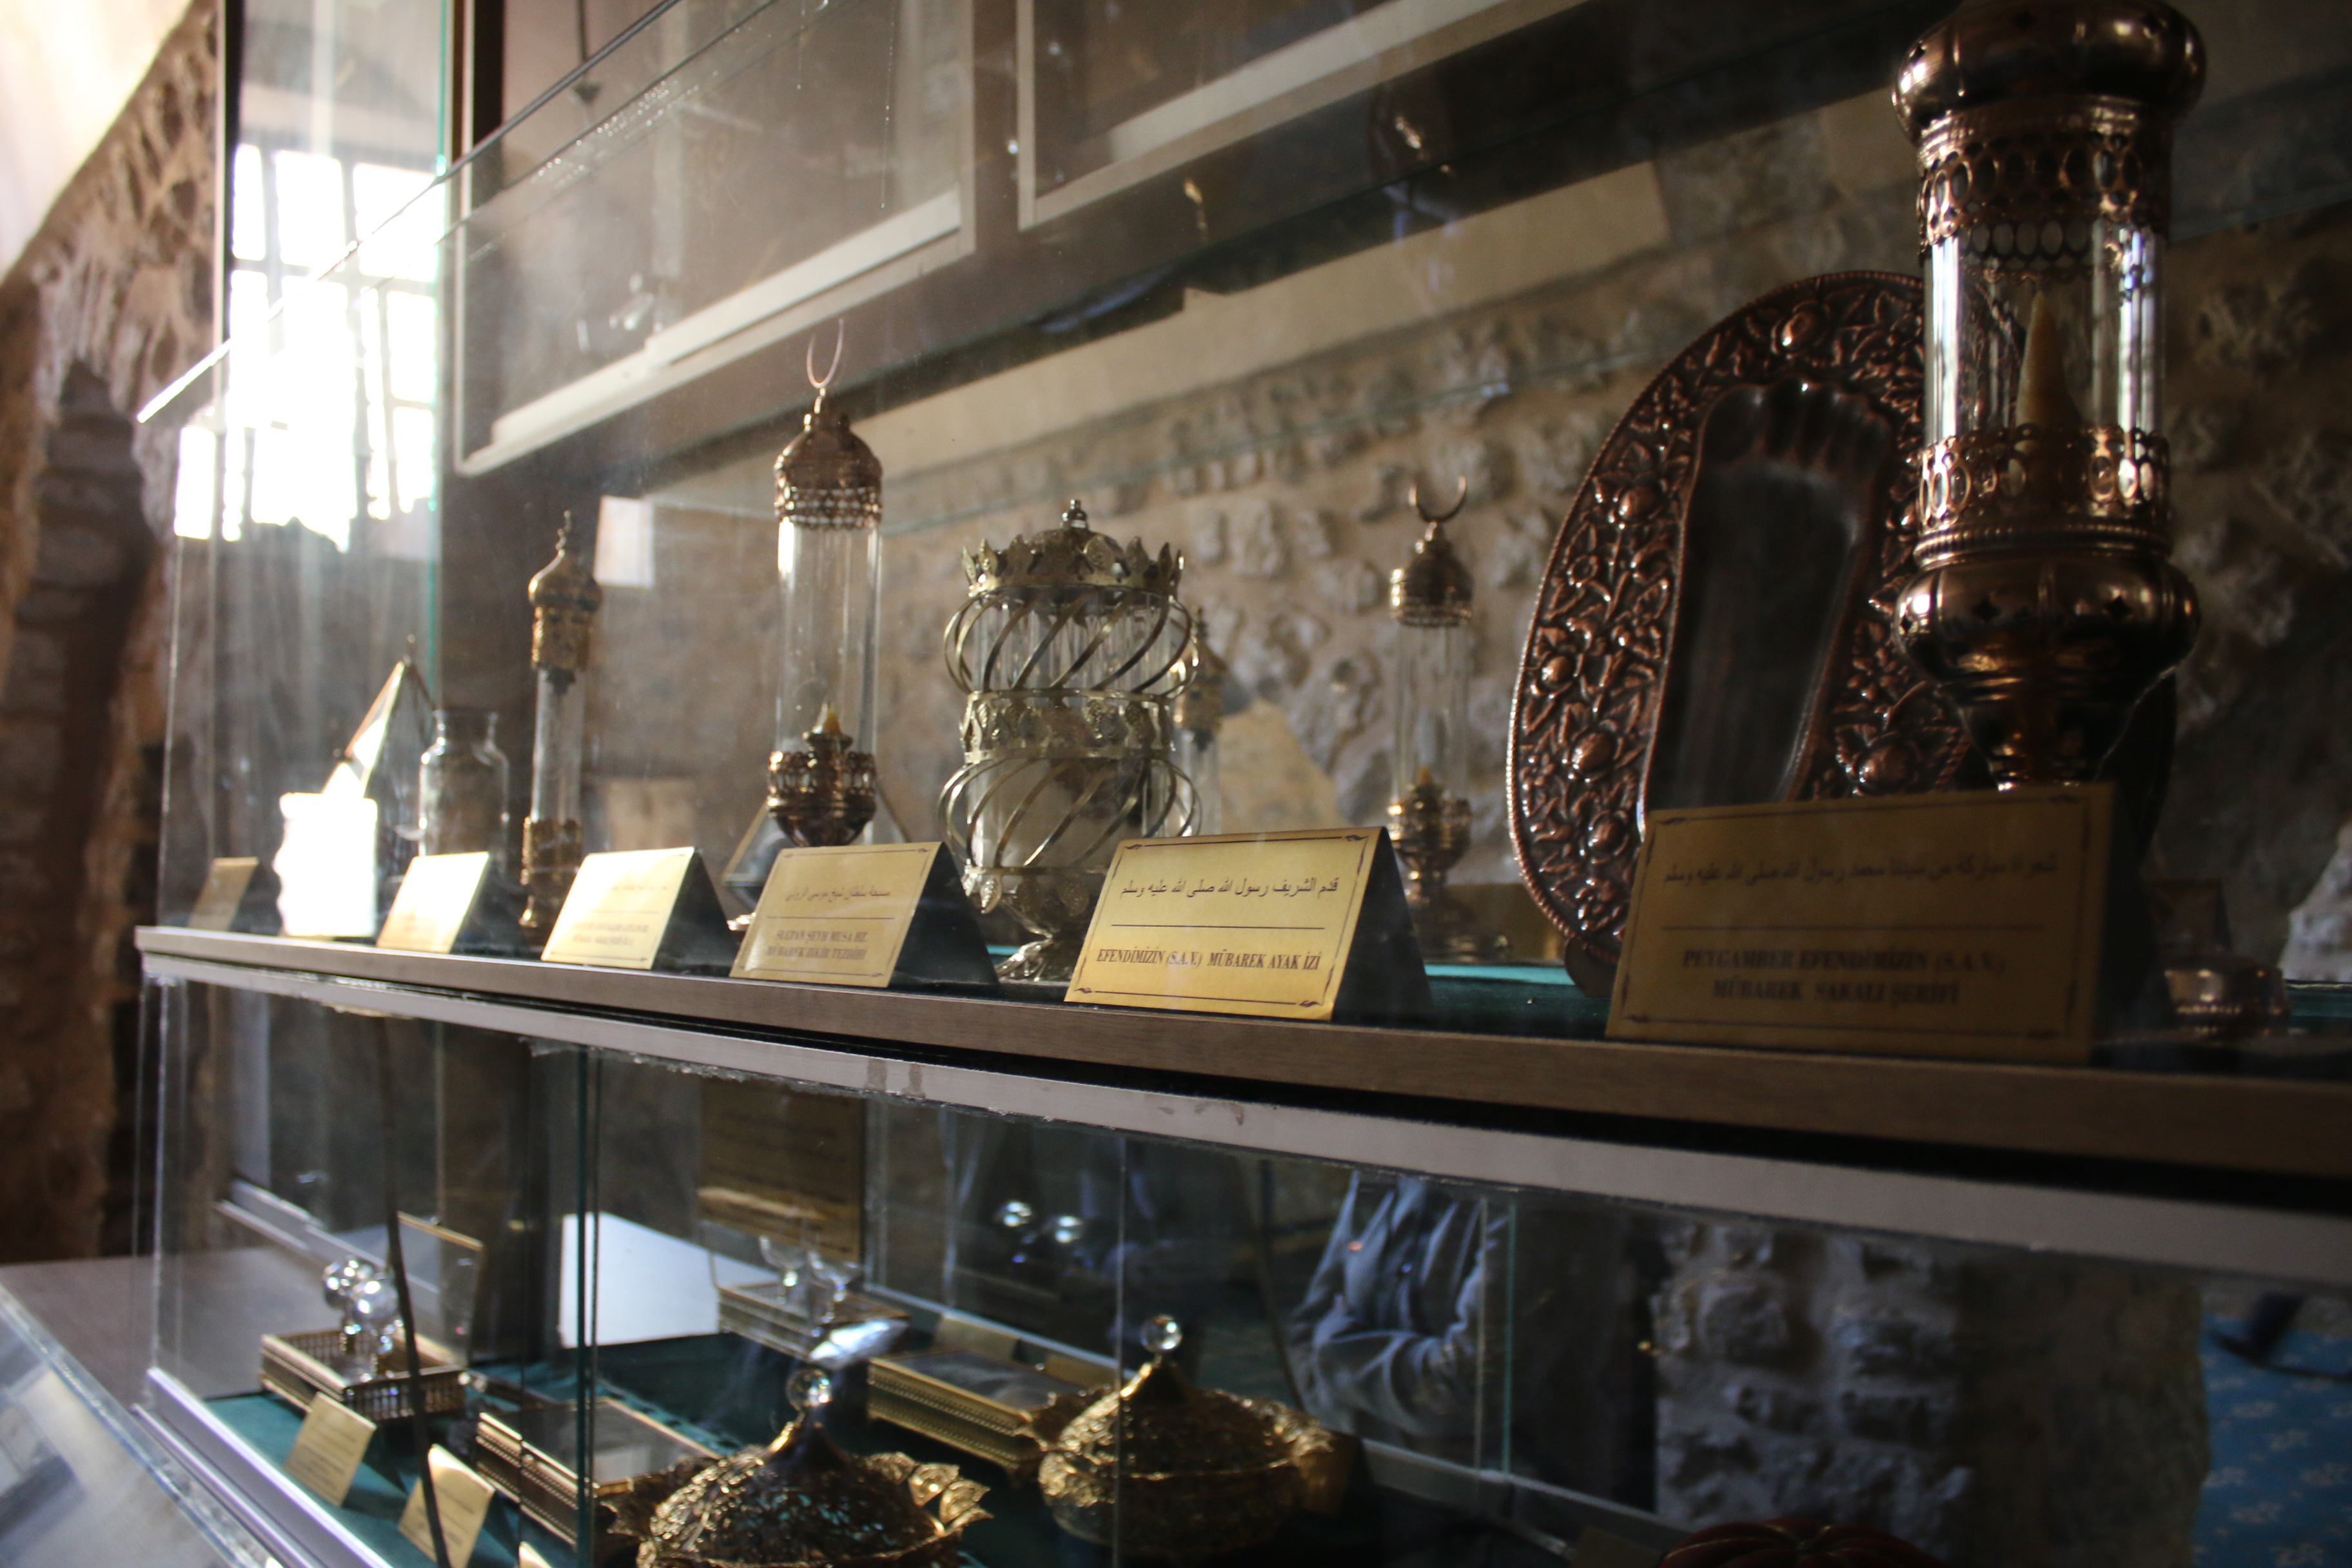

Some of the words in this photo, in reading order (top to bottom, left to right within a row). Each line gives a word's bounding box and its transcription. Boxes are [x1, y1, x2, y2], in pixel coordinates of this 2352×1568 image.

[1120, 879, 1145, 899] وسلم
[1147, 879, 1168, 897] عليه
[1171, 879, 1186, 893] الله
[1217, 877, 1233, 892] الله
[1235, 877, 1269, 897] رسول
[1097, 946, 1165, 964] EFENDİMİZİN
[1207, 949, 1266, 968] MÜBAREK
[1267, 954, 1301, 970] AYAK
[1302, 952, 1322, 970] İZİ
[1681, 949, 1794, 968] PEYGAMBER
[1712, 974, 1803, 1001] MÜBAREK
